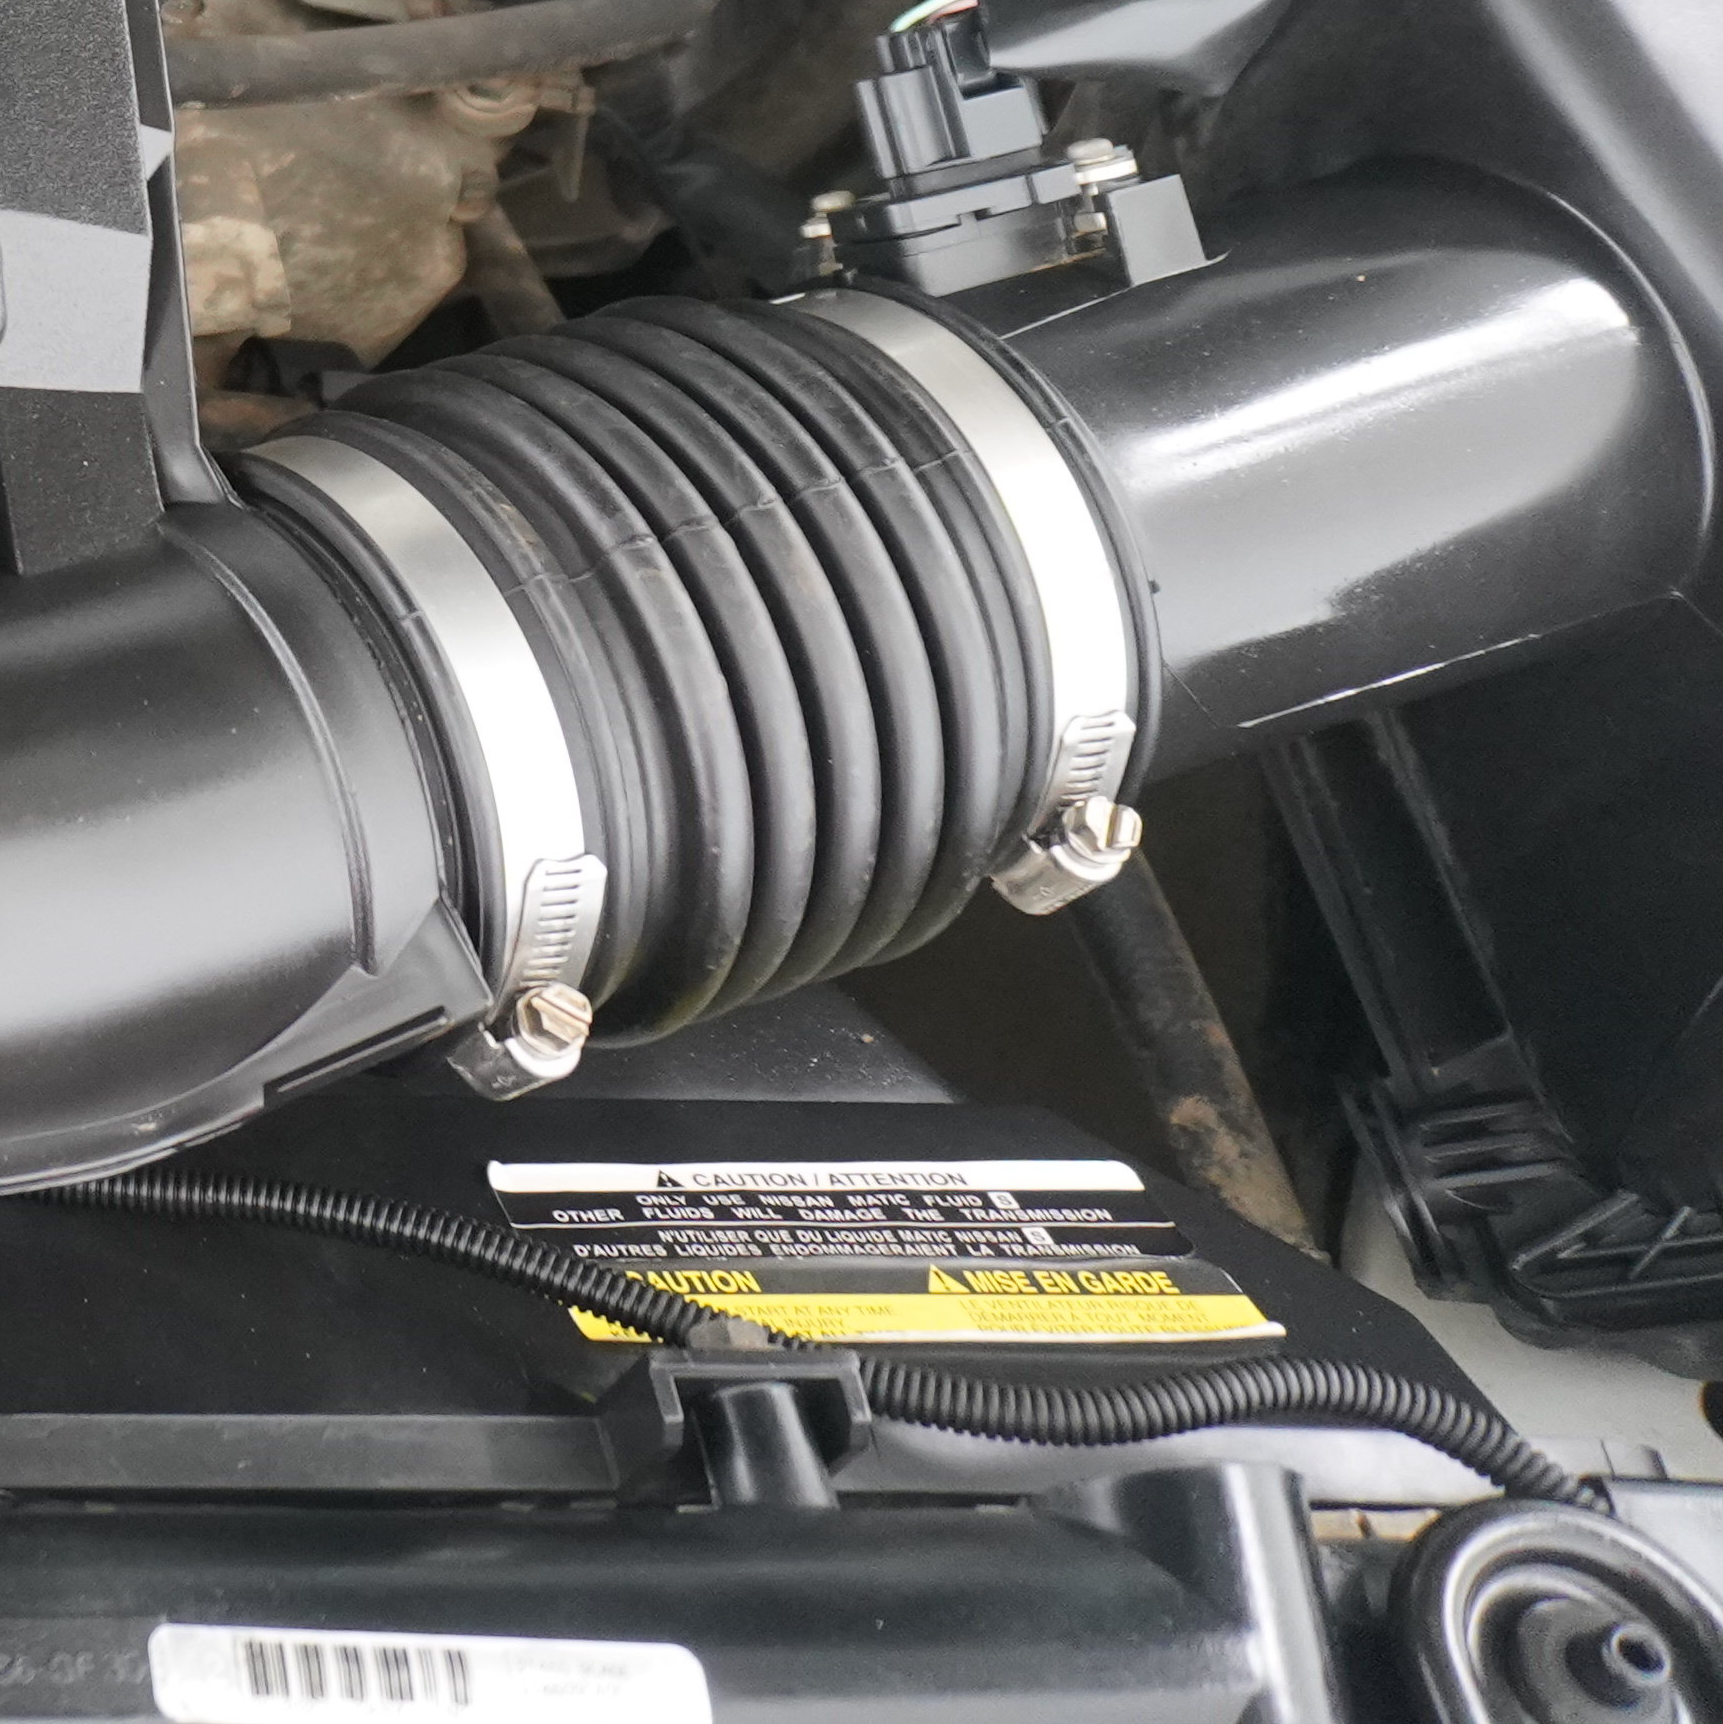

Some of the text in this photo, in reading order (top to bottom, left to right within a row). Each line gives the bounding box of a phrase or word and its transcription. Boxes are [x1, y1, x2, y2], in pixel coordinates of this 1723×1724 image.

[692, 1173, 807, 1188] CAUTION
[828, 1172, 969, 1187] ATTENTION
[635, 1194, 688, 1206] ONLY
[702, 1193, 746, 1206] USE
[758, 1193, 835, 1208] NISSAN
[847, 1193, 911, 1208] MATIC
[922, 1193, 983, 1208] FLUID
[552, 1207, 1114, 1223] OTHER FLUIDS WILL DAMAGE THE TRANSMISSION
[657, 1229, 752, 1243] N'UTILISER
[755, 1229, 794, 1244] QUE
[796, 1229, 824, 1243] DU
[825, 1229, 897, 1244] LIQUIDE
[897, 1229, 953, 1243] MATIC
[955, 1229, 1023, 1243] NISSAN
[572, 1243, 668, 1258] D'AUTRES
[674, 1243, 763, 1257] LIQUIDES
[966, 1243, 996, 1257] LA
[996, 1243, 1142, 1257] TRANSMISSION
[962, 1270, 1182, 1294] MISE EN GARDE
